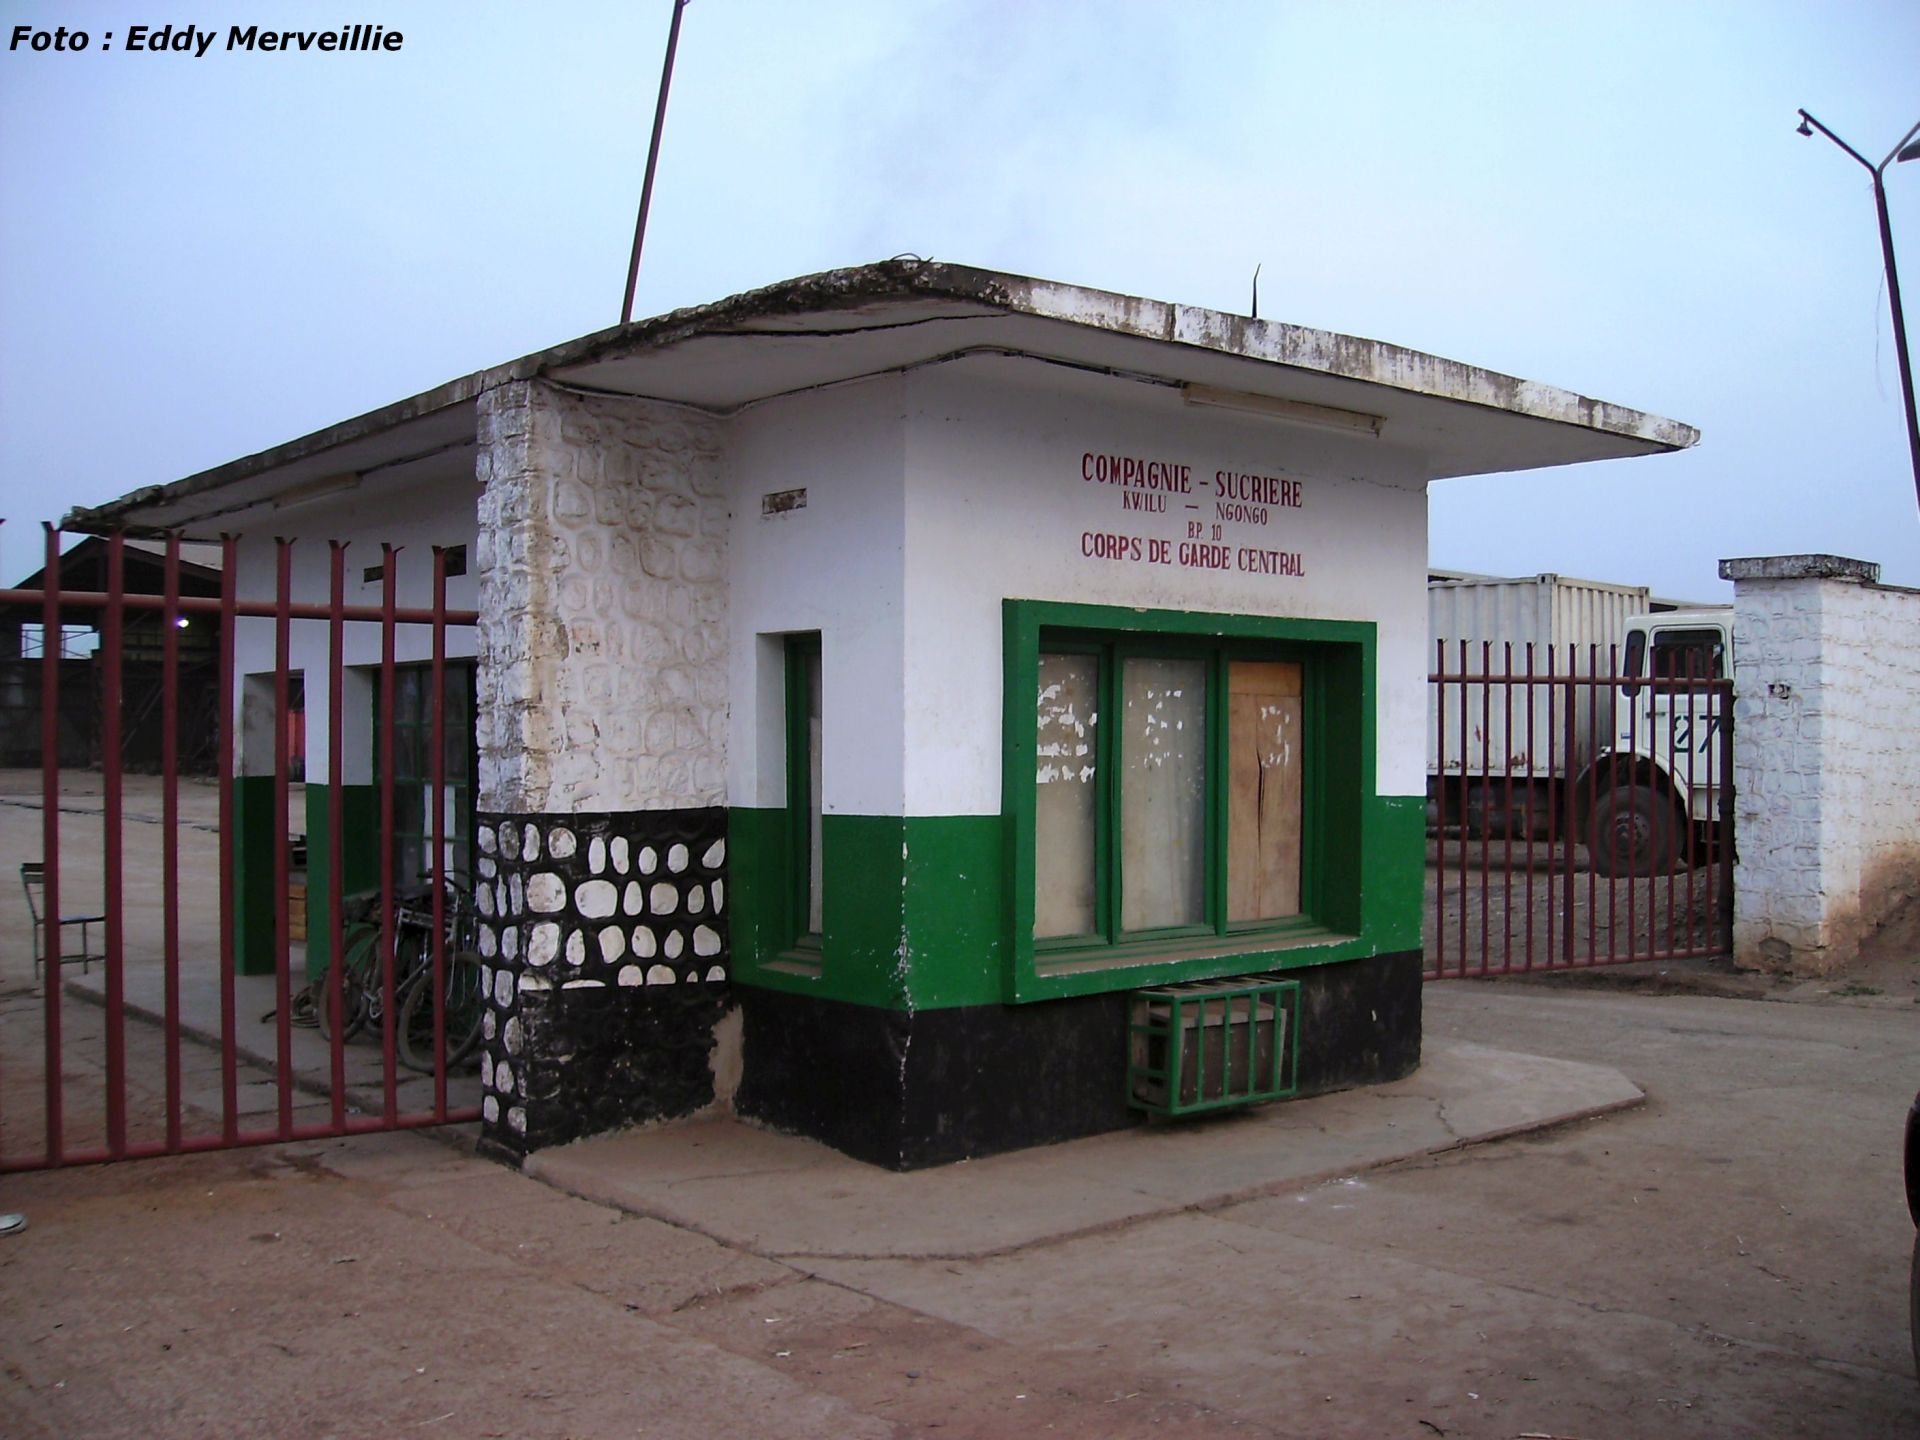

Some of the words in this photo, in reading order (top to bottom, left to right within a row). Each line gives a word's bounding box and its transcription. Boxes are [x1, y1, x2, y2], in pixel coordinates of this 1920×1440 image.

[1082, 452, 1192, 494] COMPAGNIE
[1215, 470, 1303, 508] SUCRIERE
[1122, 490, 1167, 513] KWILU
[1215, 501, 1268, 526] NGONGO
[1211, 523, 1222, 541] 10
[1081, 531, 1142, 562] CORPS
[1148, 539, 1172, 565] DE
[1178, 541, 1231, 570] GARDE
[1237, 548, 1305, 577] CENTRAL
[1674, 715, 1722, 754] 27
